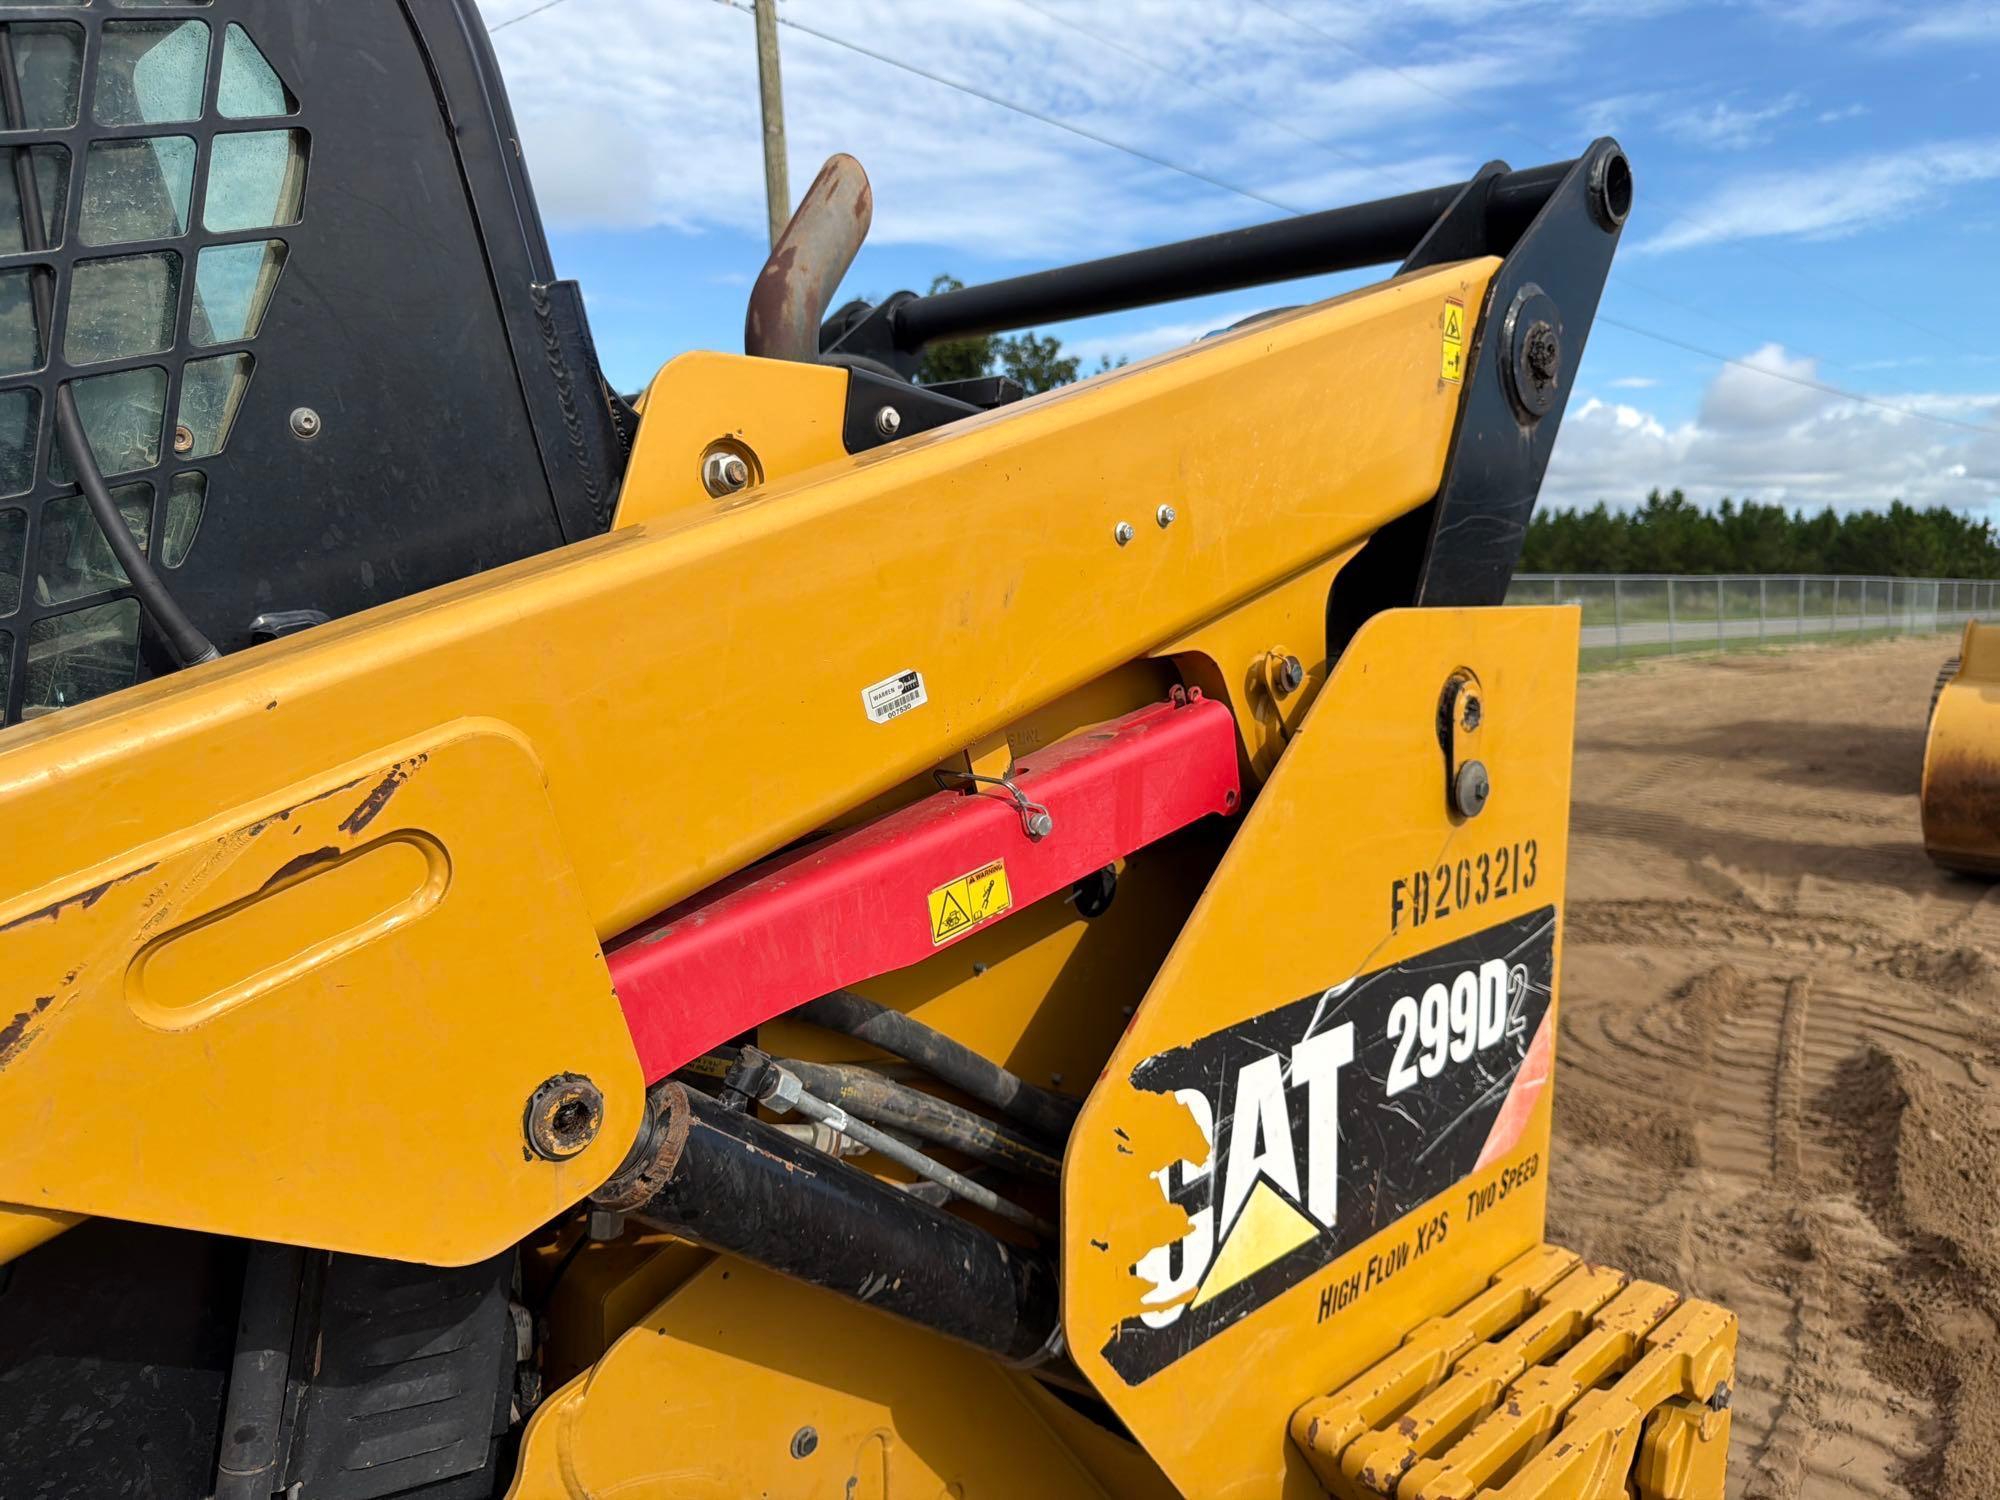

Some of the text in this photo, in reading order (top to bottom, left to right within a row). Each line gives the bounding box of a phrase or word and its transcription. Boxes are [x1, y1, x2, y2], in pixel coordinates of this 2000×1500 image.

[873, 687, 895, 701] WARREN
[975, 863, 1003, 881] WARNING
[1391, 839, 1537, 935] FD203213
[1413, 1211, 1448, 1260] XPS
